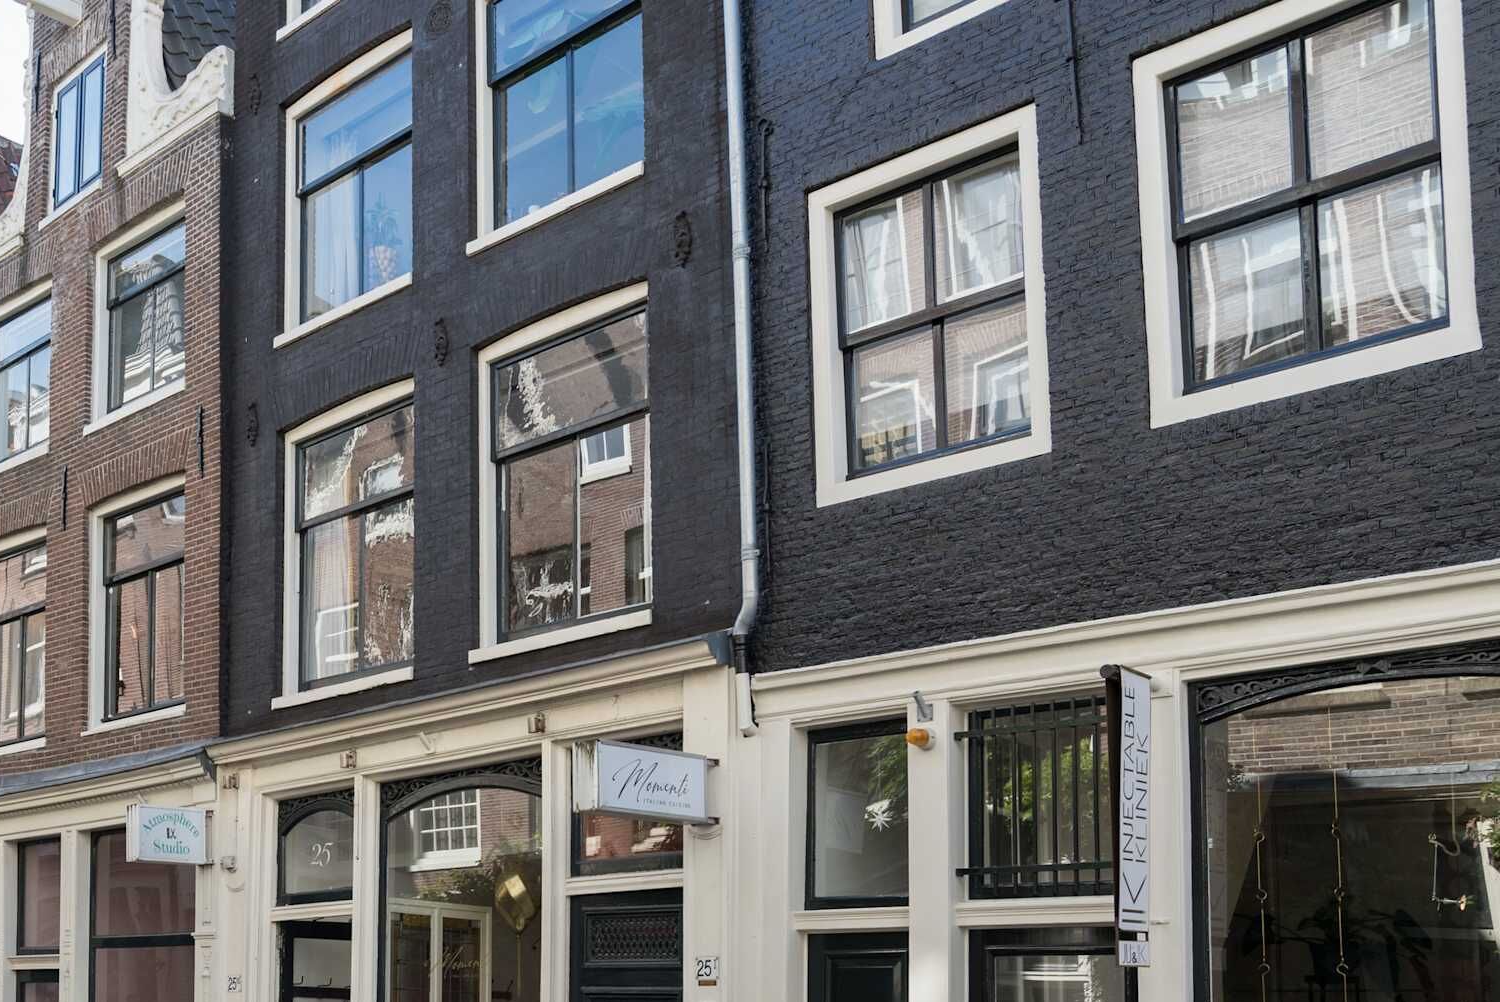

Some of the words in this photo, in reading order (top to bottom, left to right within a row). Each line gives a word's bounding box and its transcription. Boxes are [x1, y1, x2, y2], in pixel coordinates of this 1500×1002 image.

[611, 758, 689, 803] Momenti
[1122, 686, 1136, 862] INJECTABLE
[1134, 733, 1149, 863] KLINIEK
[142, 813, 200, 838] Atmosphere
[153, 840, 190, 856] Studio
[310, 842, 334, 867] 25
